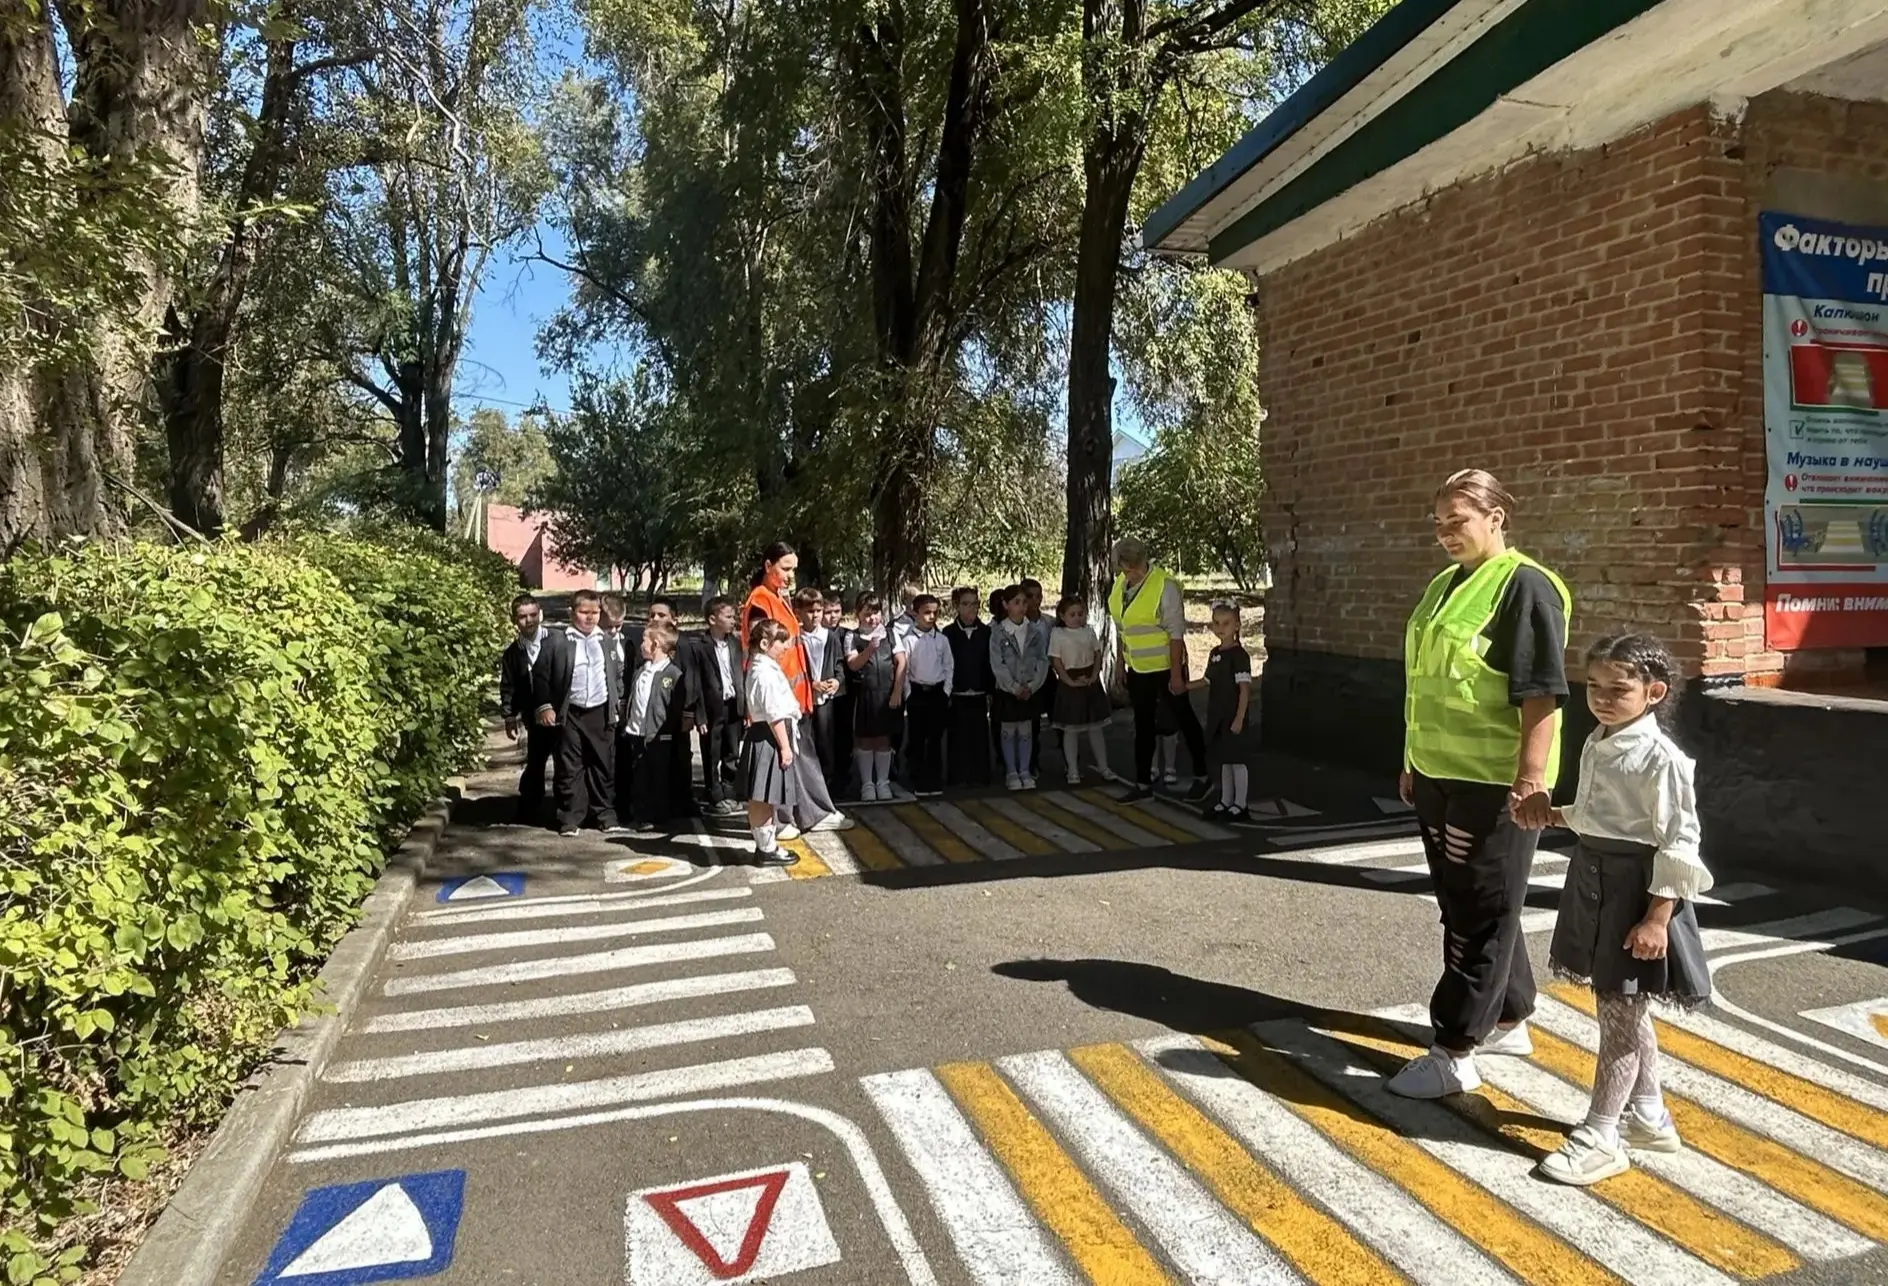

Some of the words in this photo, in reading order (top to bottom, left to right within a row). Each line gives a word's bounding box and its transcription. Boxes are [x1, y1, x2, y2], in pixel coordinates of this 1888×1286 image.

[1813, 304, 1880, 322] Капон
[1787, 452, 1837, 468] Музыка
[1840, 457, 1850, 467] в
[1775, 593, 1841, 613] Помни:
